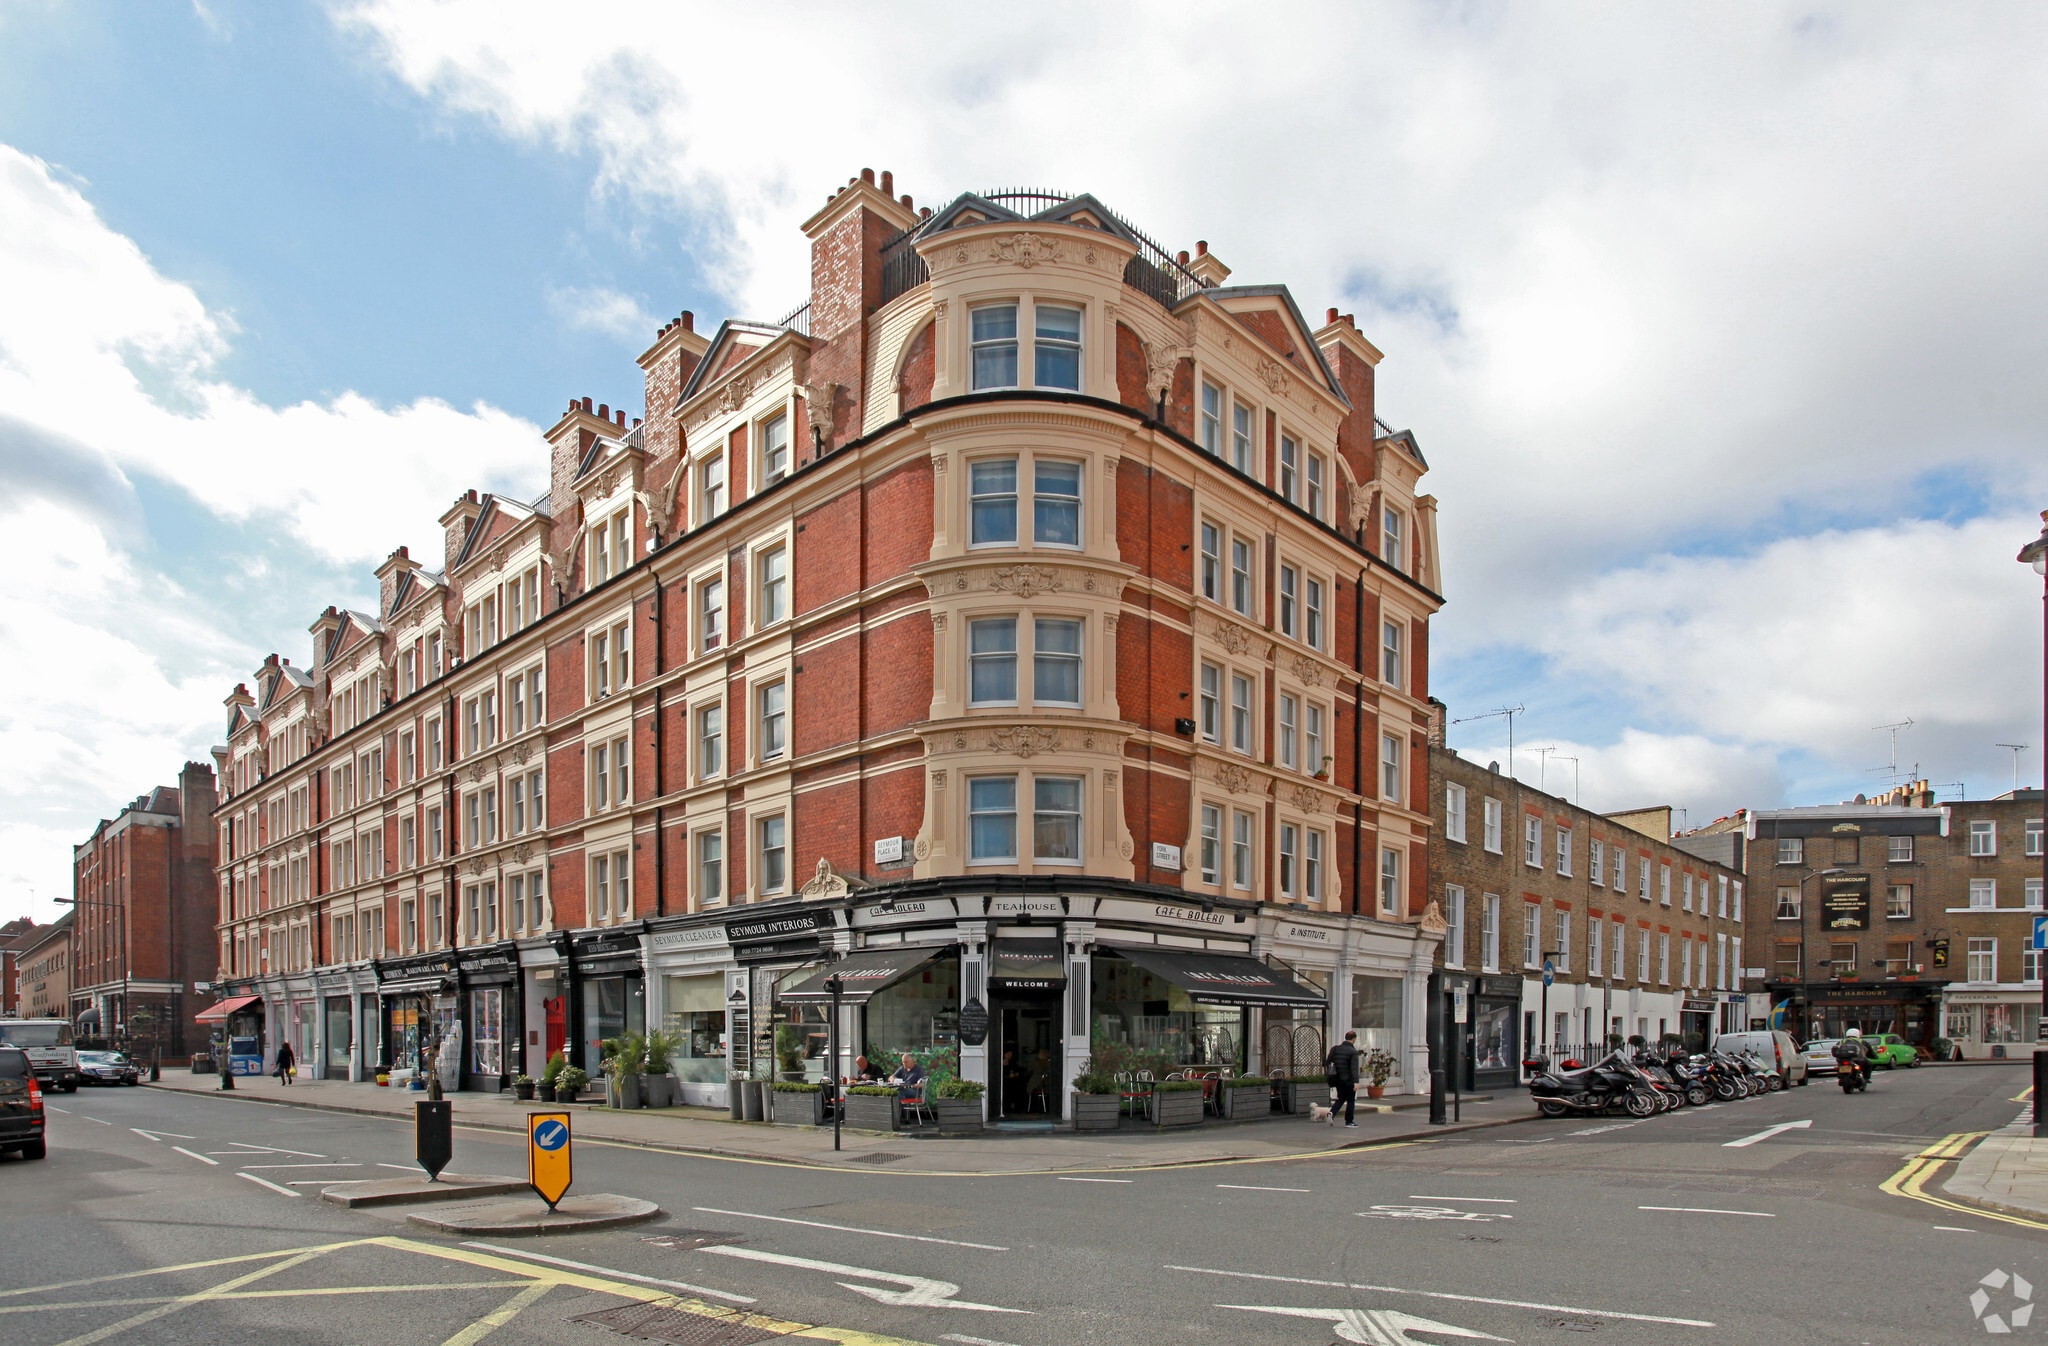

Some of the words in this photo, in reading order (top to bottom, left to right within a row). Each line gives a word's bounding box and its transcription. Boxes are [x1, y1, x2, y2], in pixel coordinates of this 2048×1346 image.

[877, 839, 899, 849] SEYMOUR
[877, 847, 891, 856] PLACE
[1156, 852, 1170, 861] STREET
[995, 903, 1057, 911] TEAHOUSE
[1155, 905, 1183, 918] CAFE
[1187, 910, 1225, 923] BOLERO
[730, 924, 767, 937] SEYMOUR
[769, 917, 815, 933] INTERIORS
[654, 934, 685, 945] SEYMOUR
[685, 930, 723, 942] CLEANERS
[1297, 928, 1326, 940] INSTITUTE
[30, 1051, 69, 1060] Scaffolding
